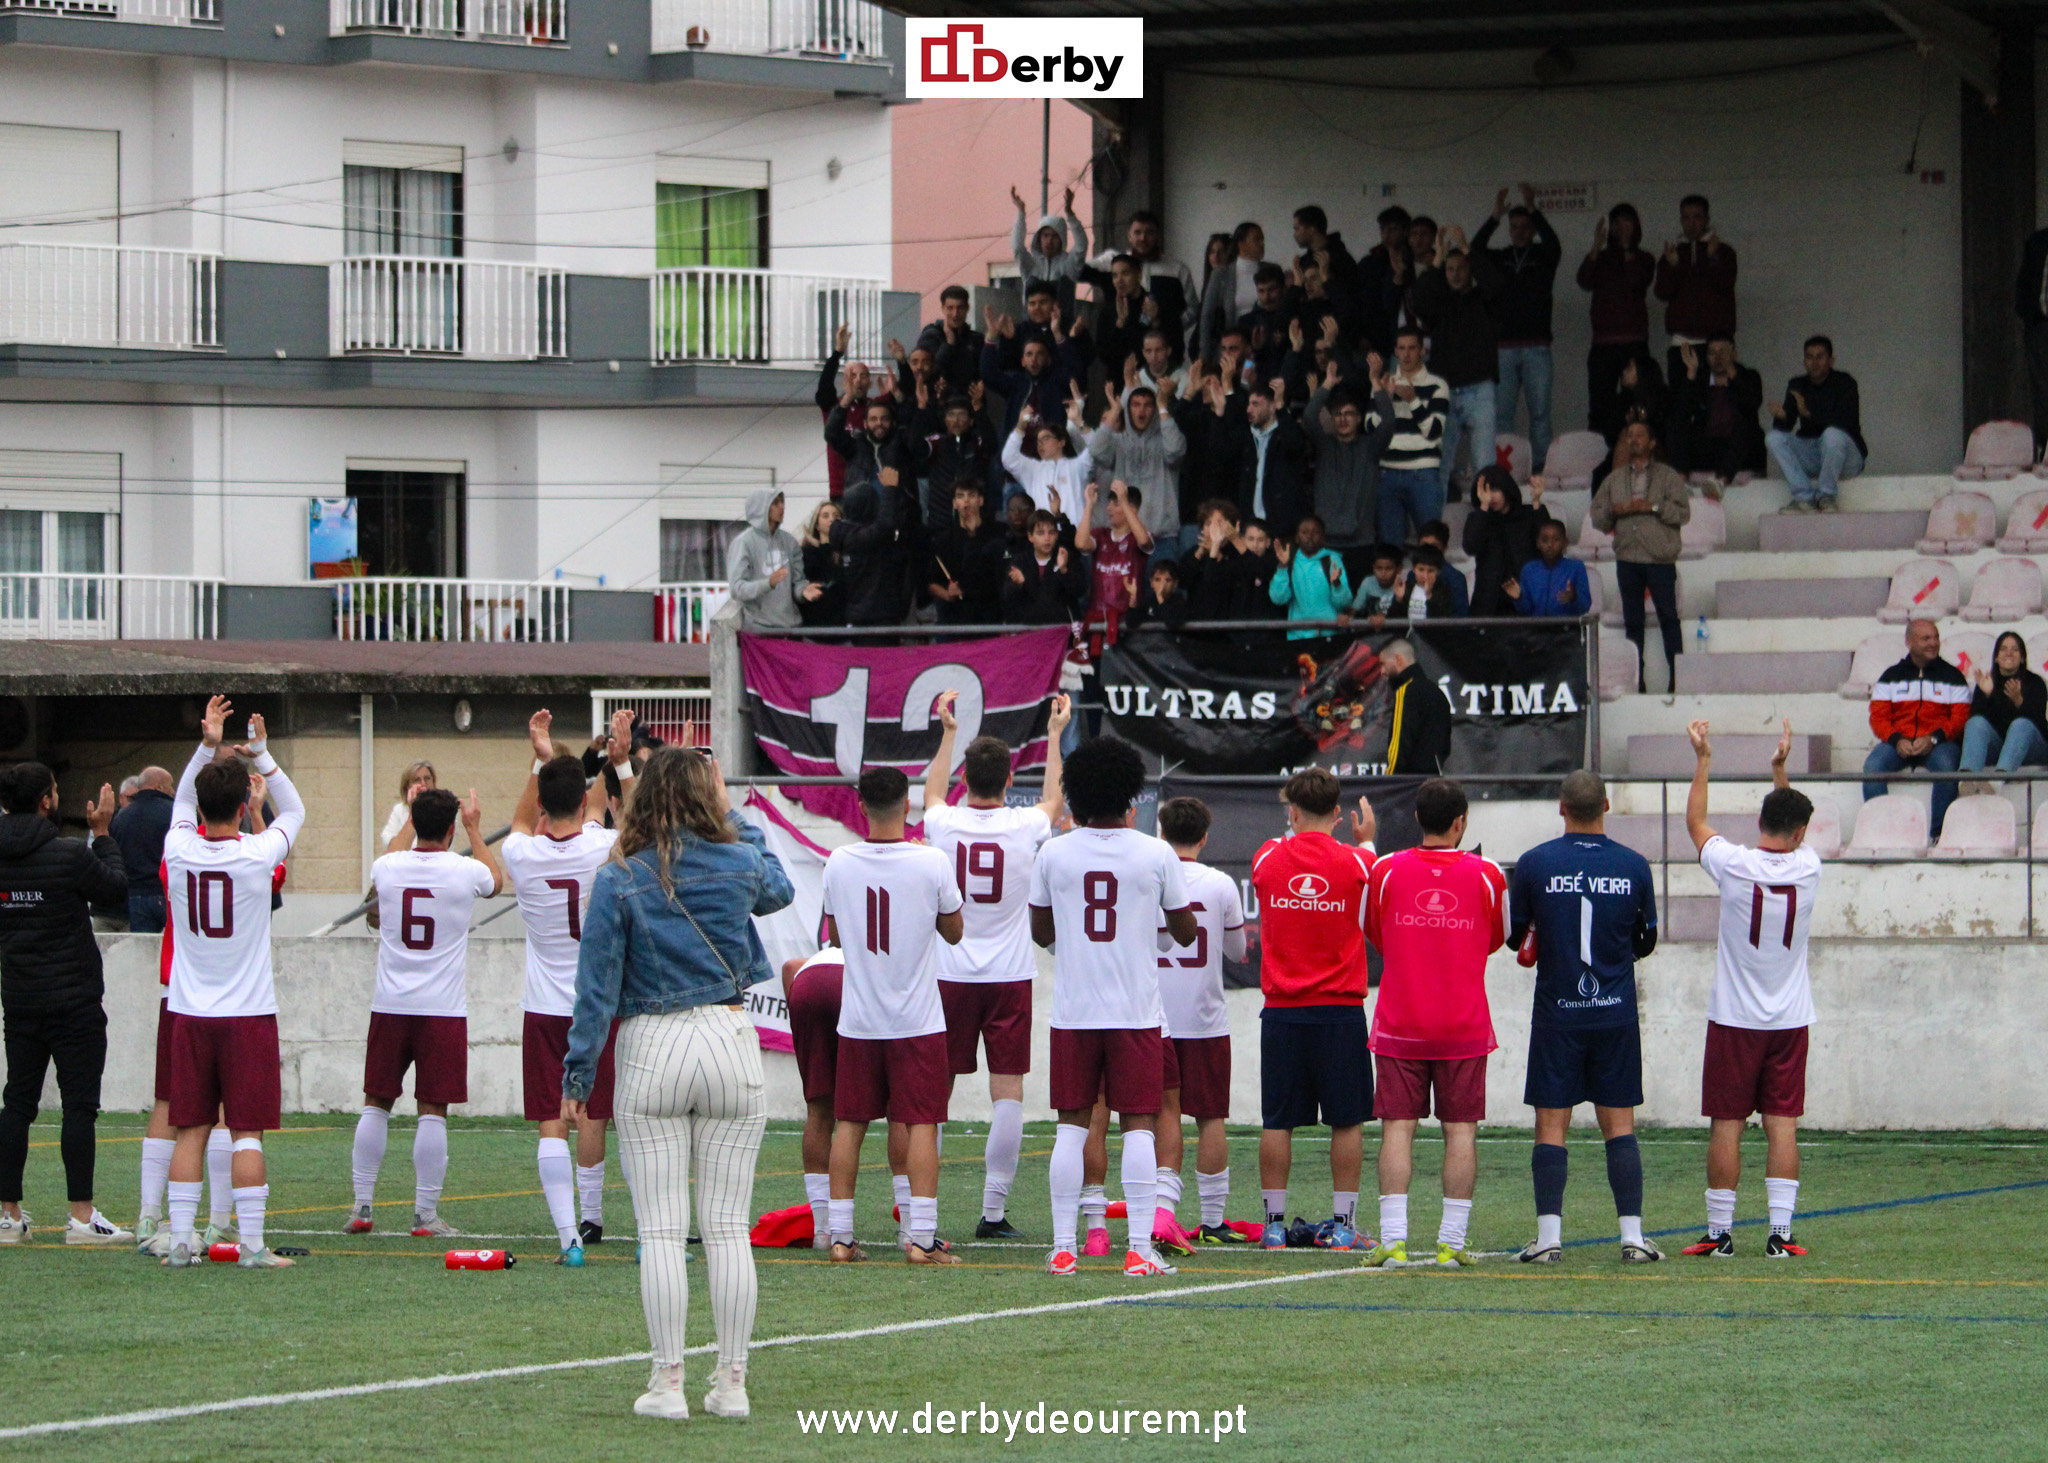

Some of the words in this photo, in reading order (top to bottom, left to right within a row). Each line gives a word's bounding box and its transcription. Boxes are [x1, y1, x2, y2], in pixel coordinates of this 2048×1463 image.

[1104, 685, 1276, 720] ULTRAS
[11, 891, 45, 901] BEER
[956, 840, 1005, 904] 19
[1269, 894, 1346, 913] Lacatoni
[1545, 870, 1584, 894] JOSÉ
[1587, 876, 1632, 896] VIEIRA
[187, 869, 234, 939] 10
[401, 888, 436, 951] 6
[544, 878, 582, 943] 7
[866, 885, 890, 956] 11
[1083, 870, 1119, 943] 8
[1394, 911, 1475, 931] Lacatoni
[1580, 895, 1593, 967] 1
[1748, 881, 1798, 952] 17
[1557, 995, 1623, 1009] Constafluidos
